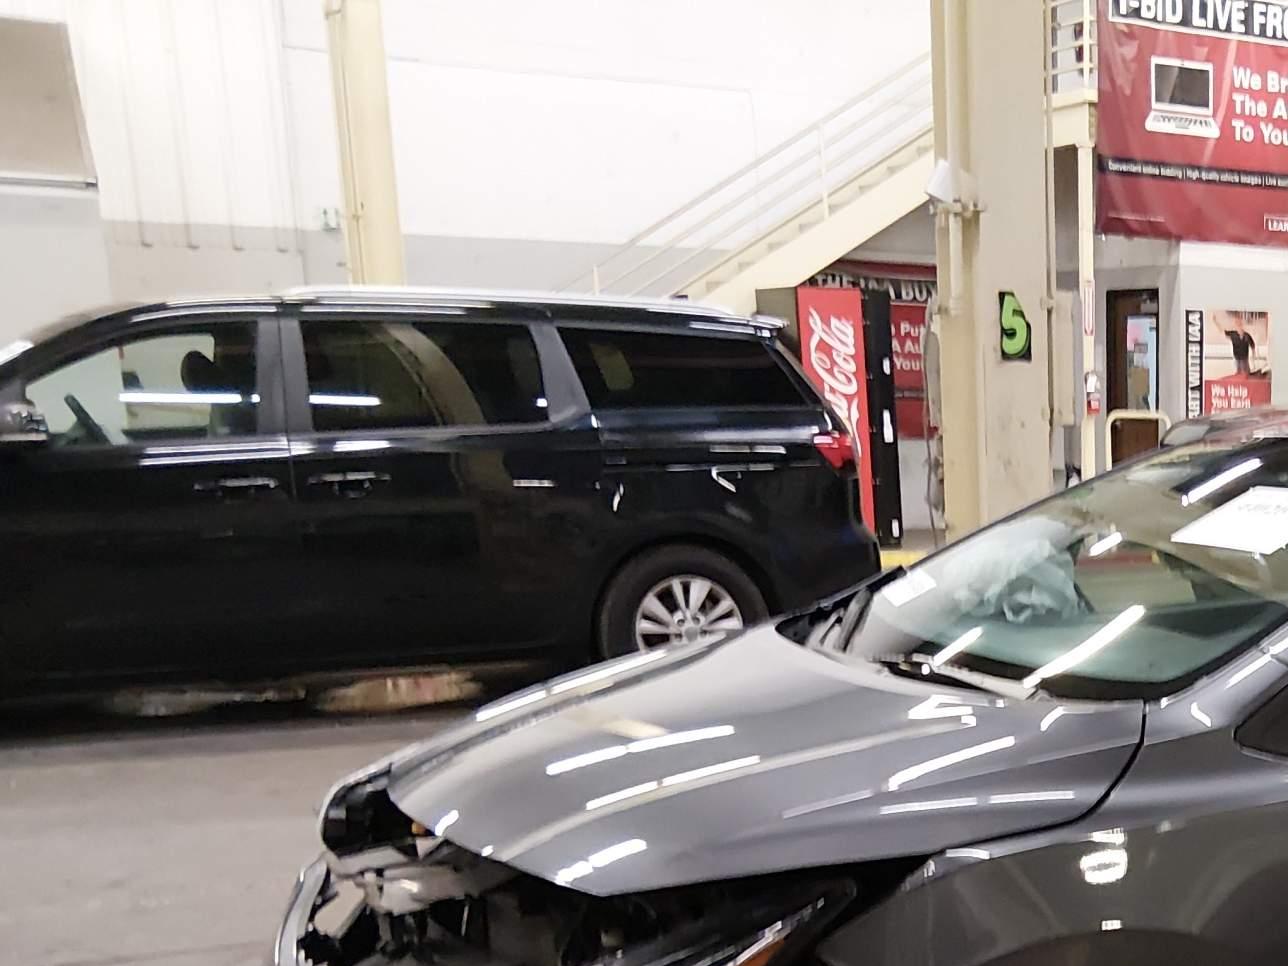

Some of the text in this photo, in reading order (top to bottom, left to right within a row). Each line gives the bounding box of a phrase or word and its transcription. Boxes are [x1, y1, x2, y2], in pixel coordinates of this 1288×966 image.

[1192, 0, 1245, 33] LIVE
[1232, 66, 1262, 91] We
[1232, 92, 1267, 117] The
[1232, 118, 1254, 142] To
[1001, 292, 1028, 356] 5
[1188, 312, 1200, 341] IAA
[1188, 343, 1200, 388] WITH
[1211, 383, 1248, 400] We Help
[1211, 397, 1251, 409] You Earn
